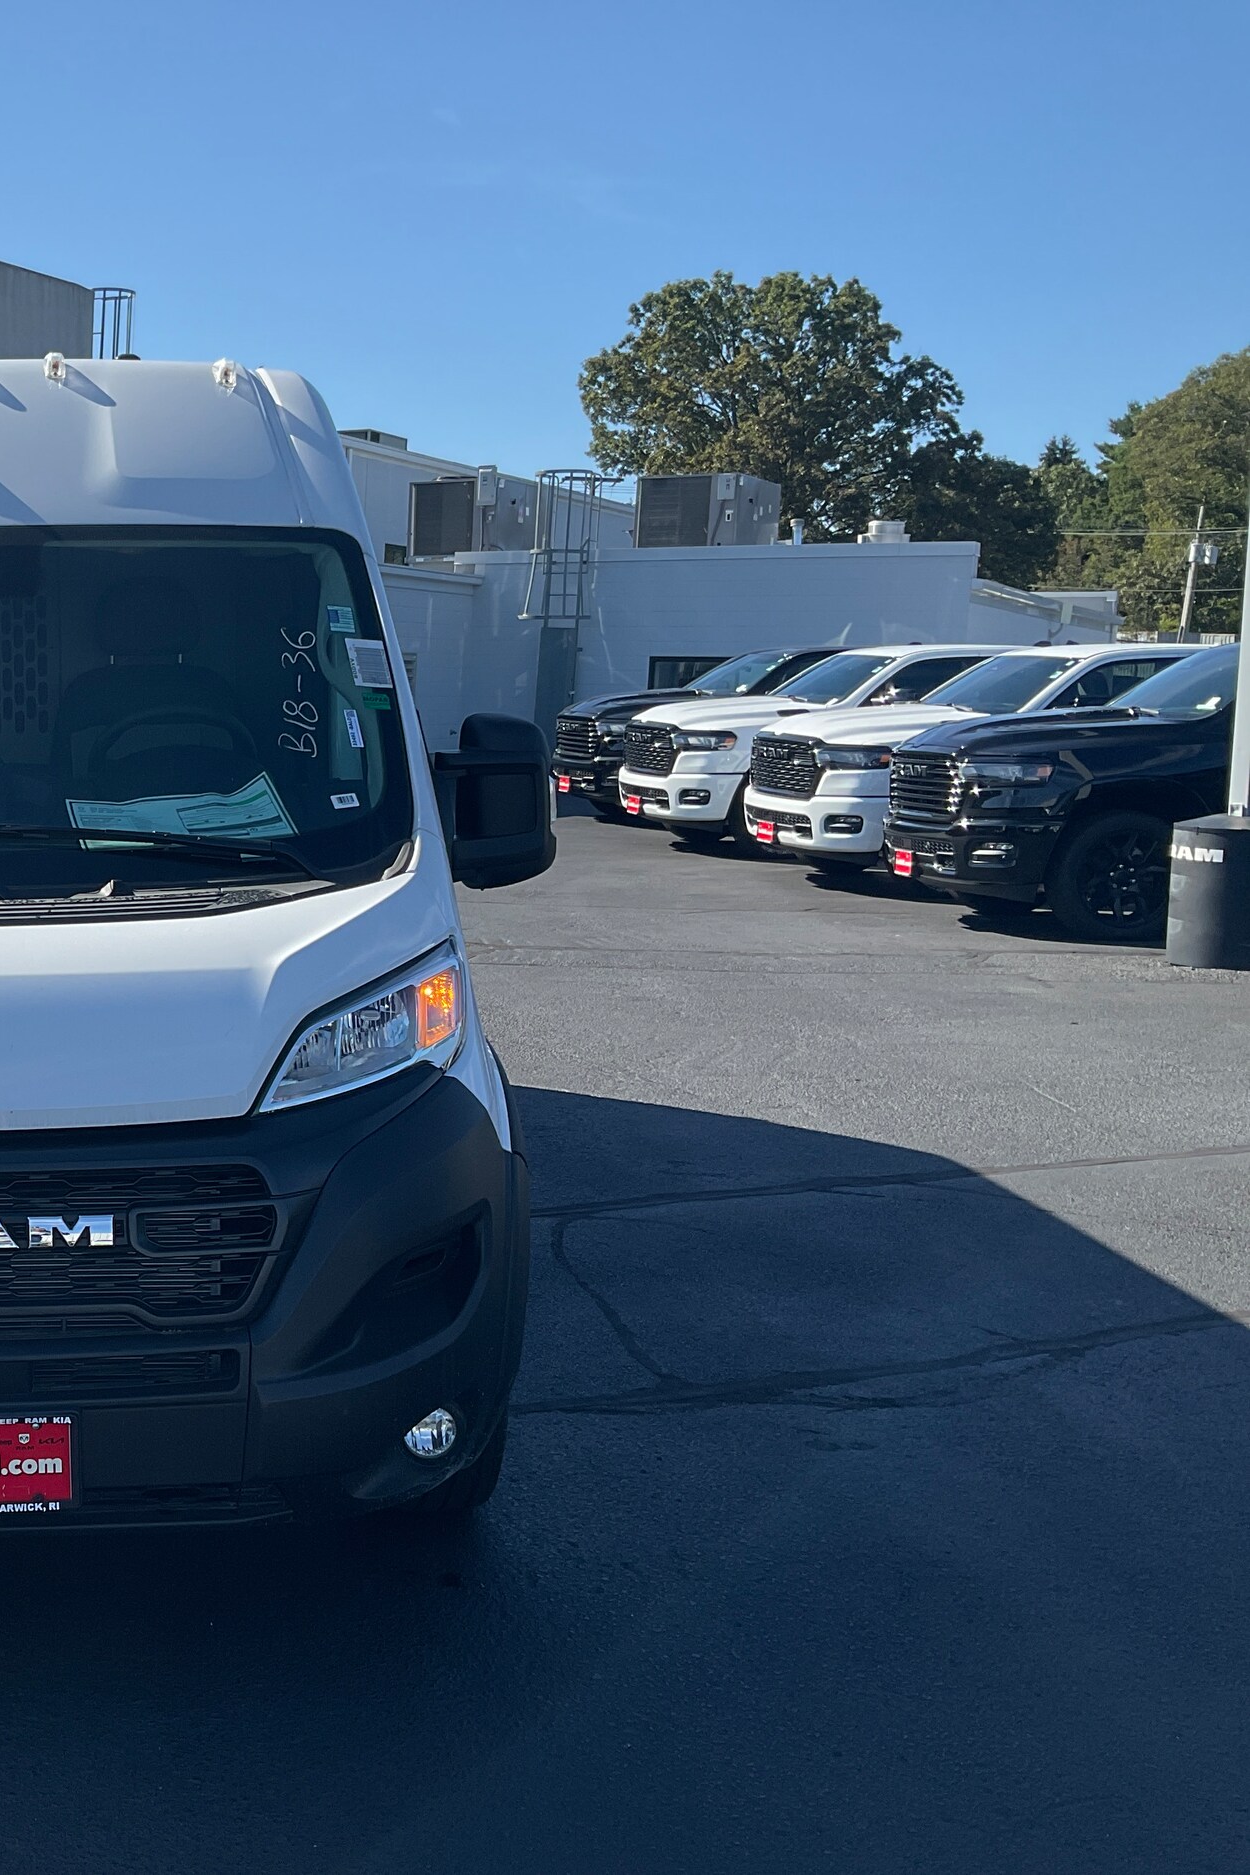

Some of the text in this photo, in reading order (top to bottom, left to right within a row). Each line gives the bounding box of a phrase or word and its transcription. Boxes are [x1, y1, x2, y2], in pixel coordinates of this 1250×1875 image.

[278, 627, 318, 758] B18-36
[895, 763, 928, 777] RAM
[24, 1416, 48, 1424] RAM
[52, 1416, 72, 1424] KIA
[48, 1501, 60, 1511] RI
